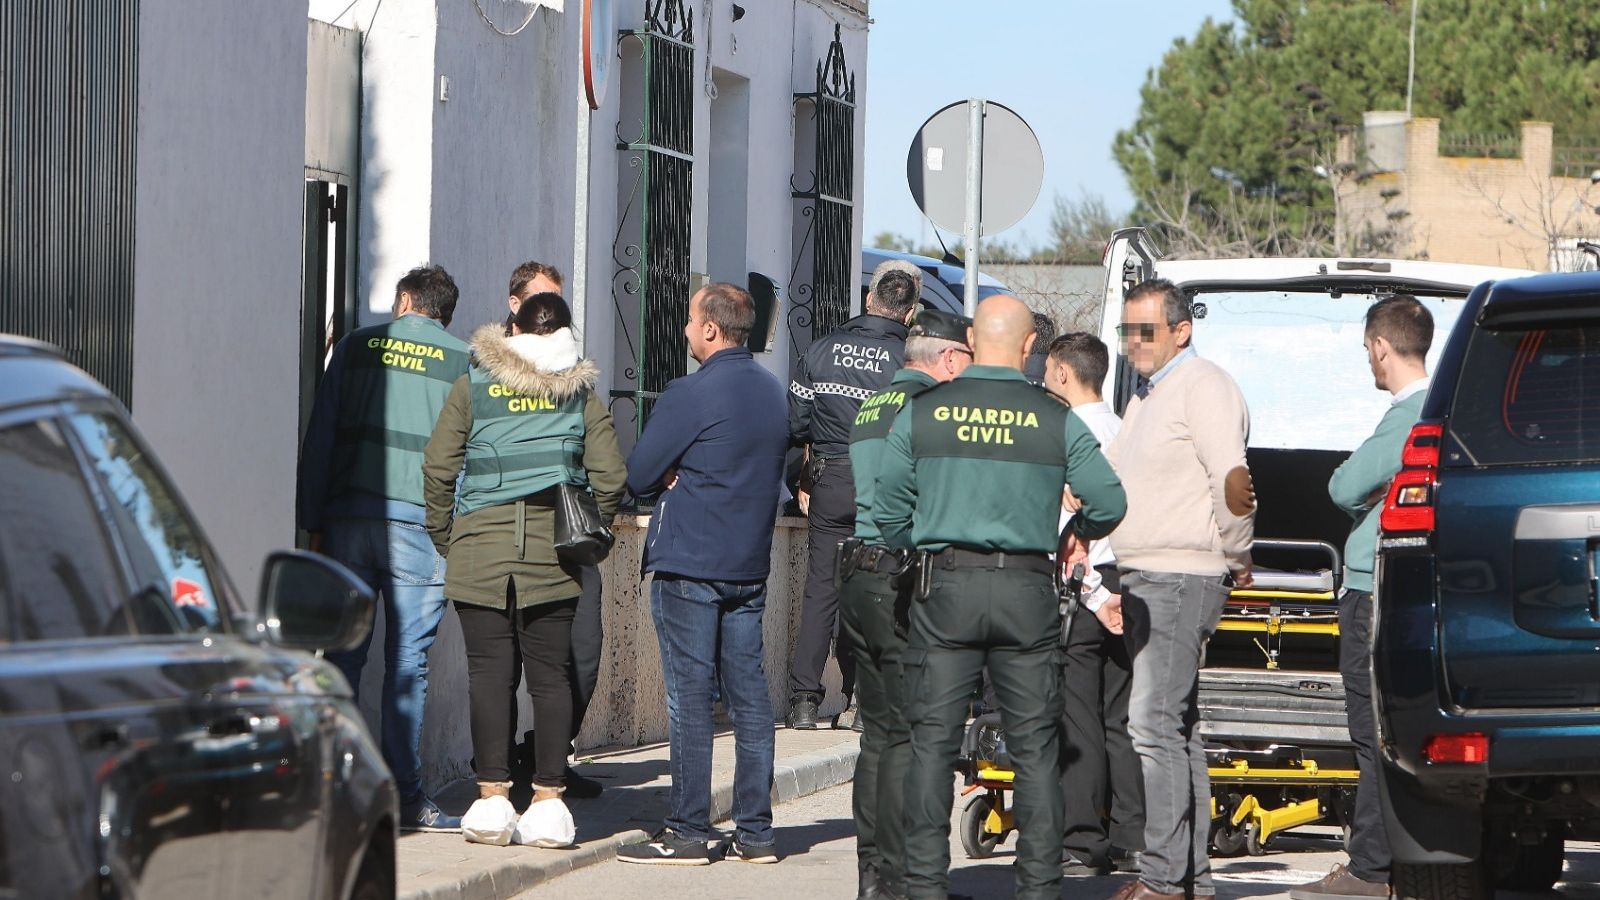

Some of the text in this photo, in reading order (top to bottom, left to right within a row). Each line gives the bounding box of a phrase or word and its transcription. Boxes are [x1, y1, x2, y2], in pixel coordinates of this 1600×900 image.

[367, 338, 445, 361] GUARDIA
[832, 343, 890, 362] POLICÍA
[381, 352, 427, 371] CIVIL
[833, 354, 883, 373] LOCAL
[508, 397, 556, 412] CIVIL
[860, 391, 906, 410] ARDIA
[855, 407, 881, 426] CIVIL
[933, 406, 1040, 428] GUARDIA
[957, 425, 1014, 445] CIVIL
